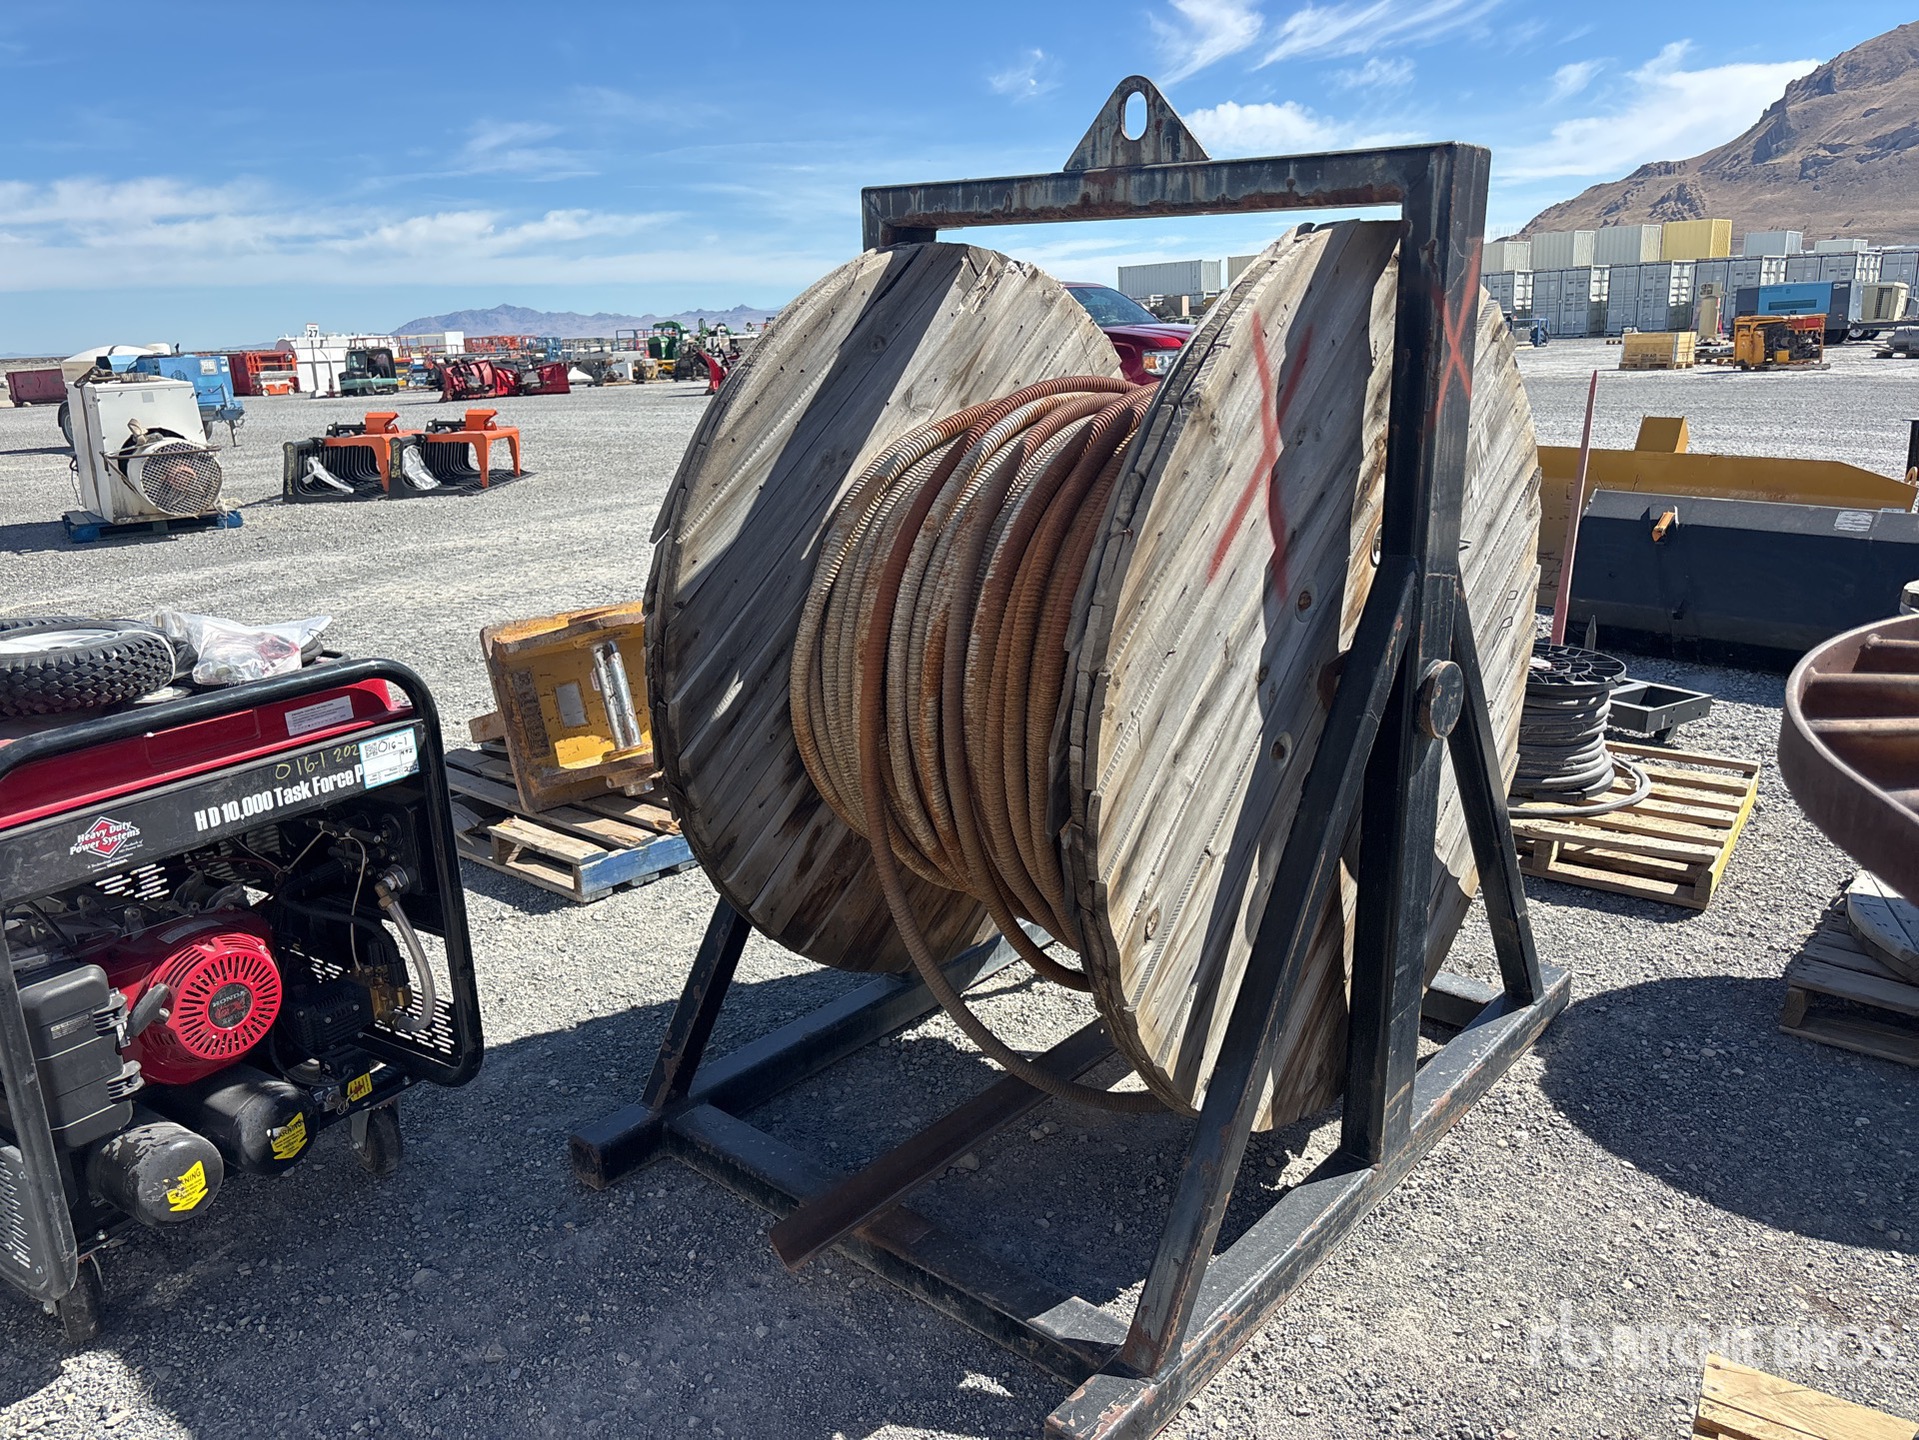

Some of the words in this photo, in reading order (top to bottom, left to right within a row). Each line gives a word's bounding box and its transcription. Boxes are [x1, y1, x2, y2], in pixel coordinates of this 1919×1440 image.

[308, 329, 318, 338] 27
[220, 790, 275, 823] 10,000
[273, 780, 312, 807] Task
[311, 769, 355, 796] Force
[69, 840, 100, 856] Power
[102, 828, 141, 846] Systems
[77, 828, 107, 843] Heavy
[109, 821, 132, 834] Duty
[212, 990, 245, 1008] HONDA
